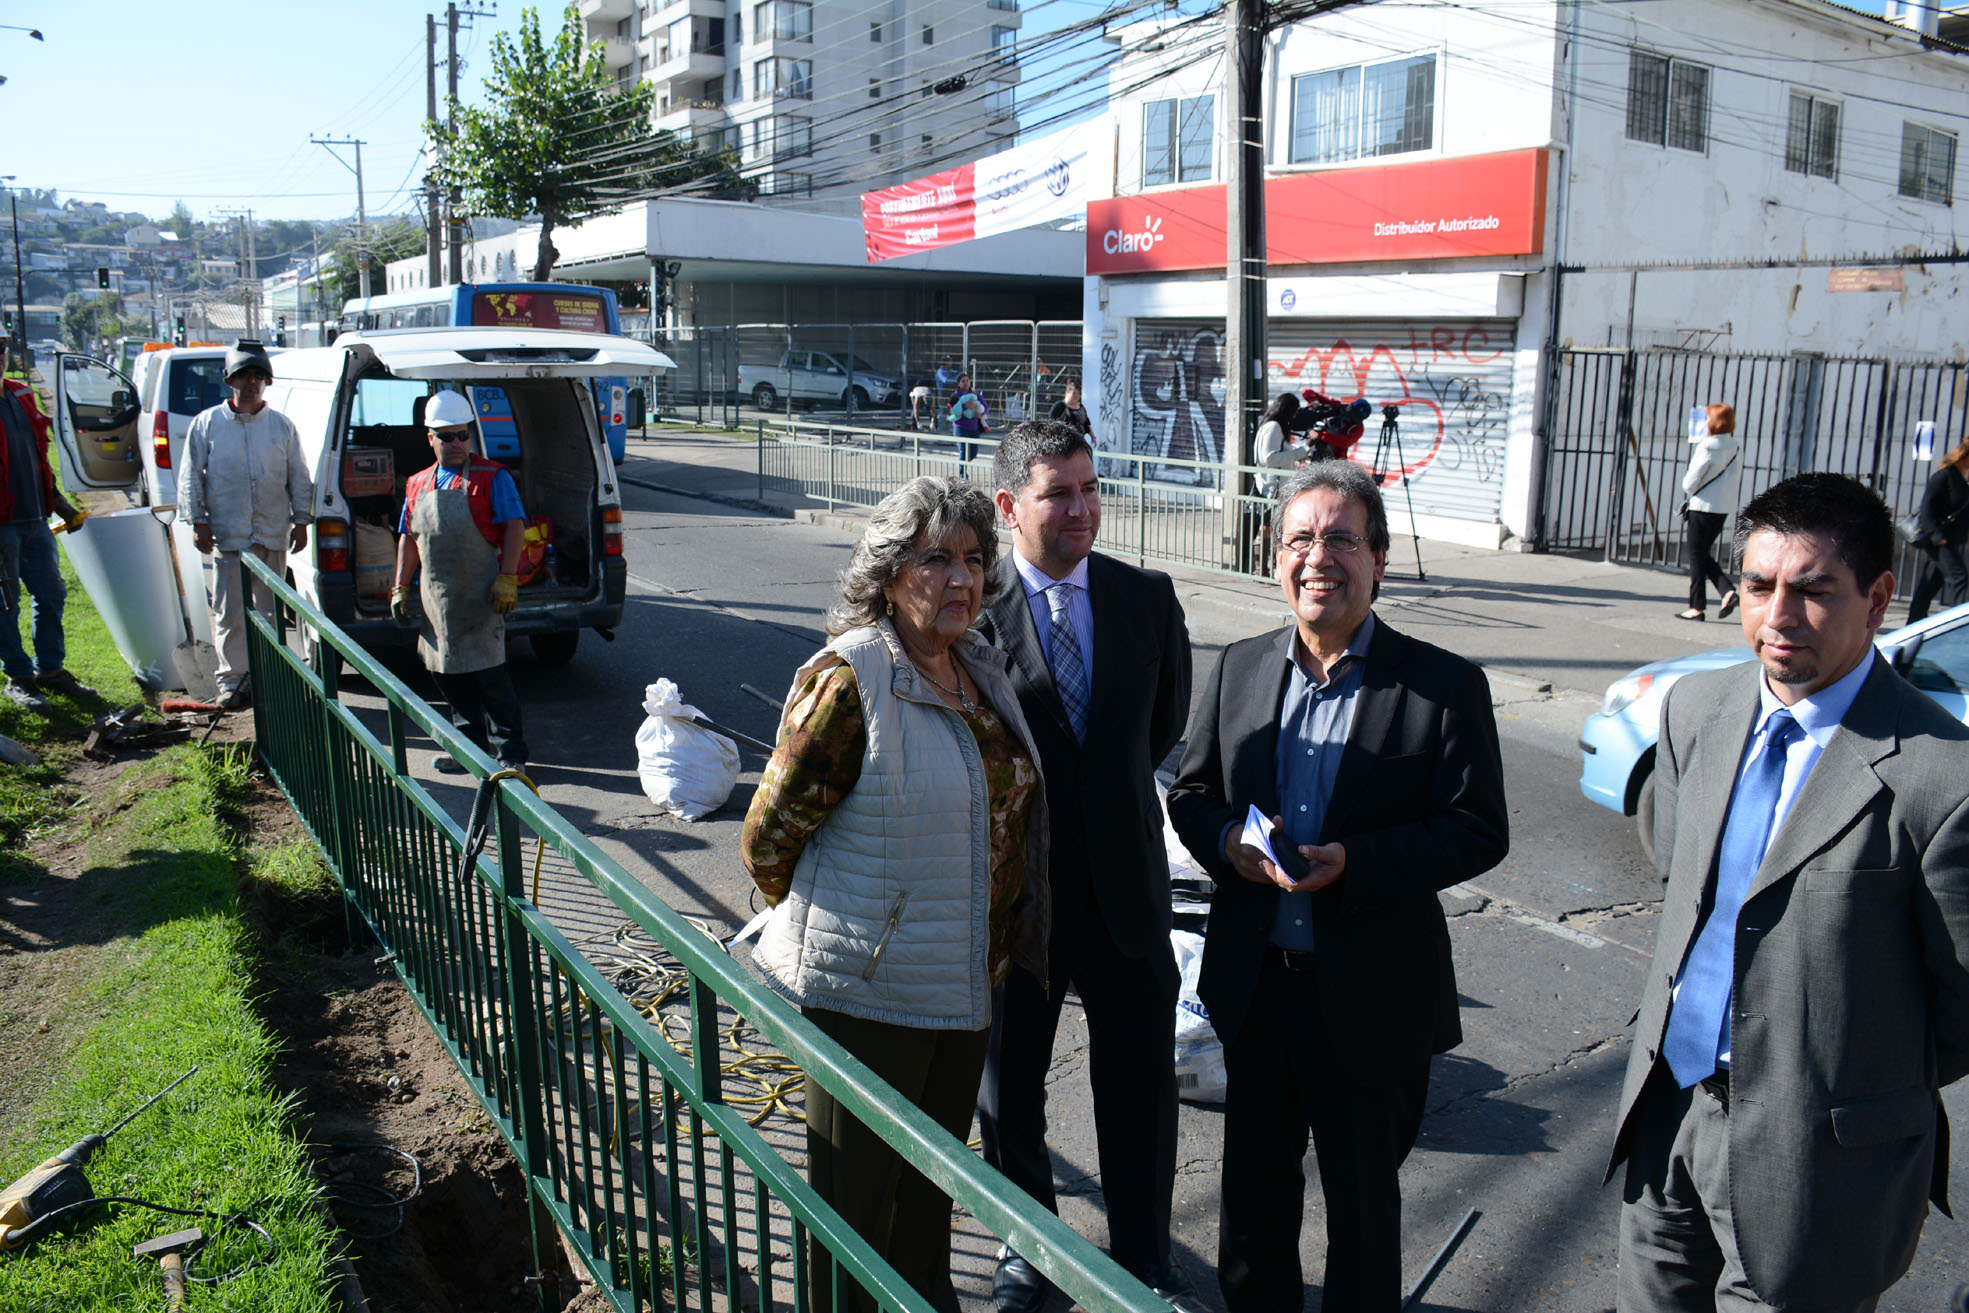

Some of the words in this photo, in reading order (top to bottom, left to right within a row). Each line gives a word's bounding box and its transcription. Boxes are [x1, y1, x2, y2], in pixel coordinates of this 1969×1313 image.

[1374, 220, 1437, 236] Distribuidor
[1437, 214, 1499, 232] Autorizado
[1104, 227, 1154, 254] Claro
